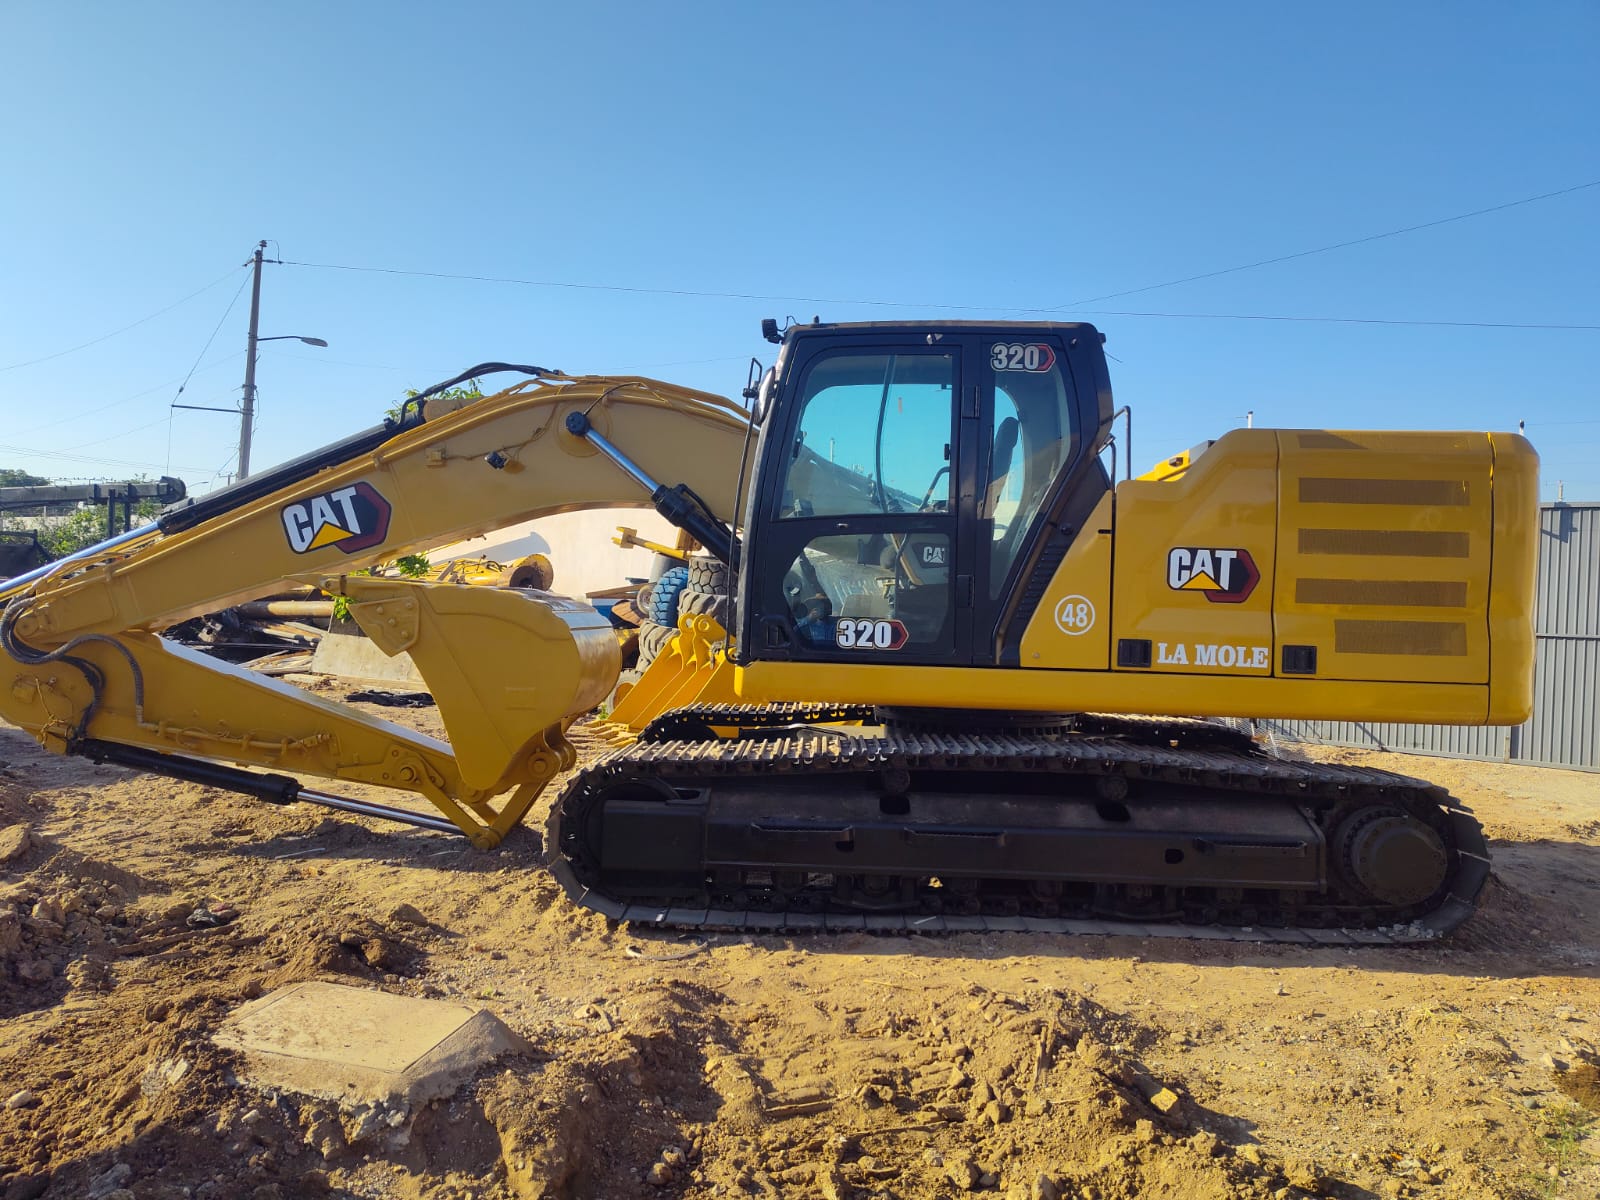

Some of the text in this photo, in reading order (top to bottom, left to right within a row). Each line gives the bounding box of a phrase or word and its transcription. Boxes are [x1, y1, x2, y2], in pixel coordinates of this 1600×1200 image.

[993, 345, 1040, 370] 320
[283, 486, 361, 553] CAT
[923, 546, 945, 563] CA
[1169, 548, 1237, 591] CAT
[1061, 603, 1088, 627] 48
[838, 620, 892, 648] 320
[1157, 642, 1268, 669] LA MOLE
